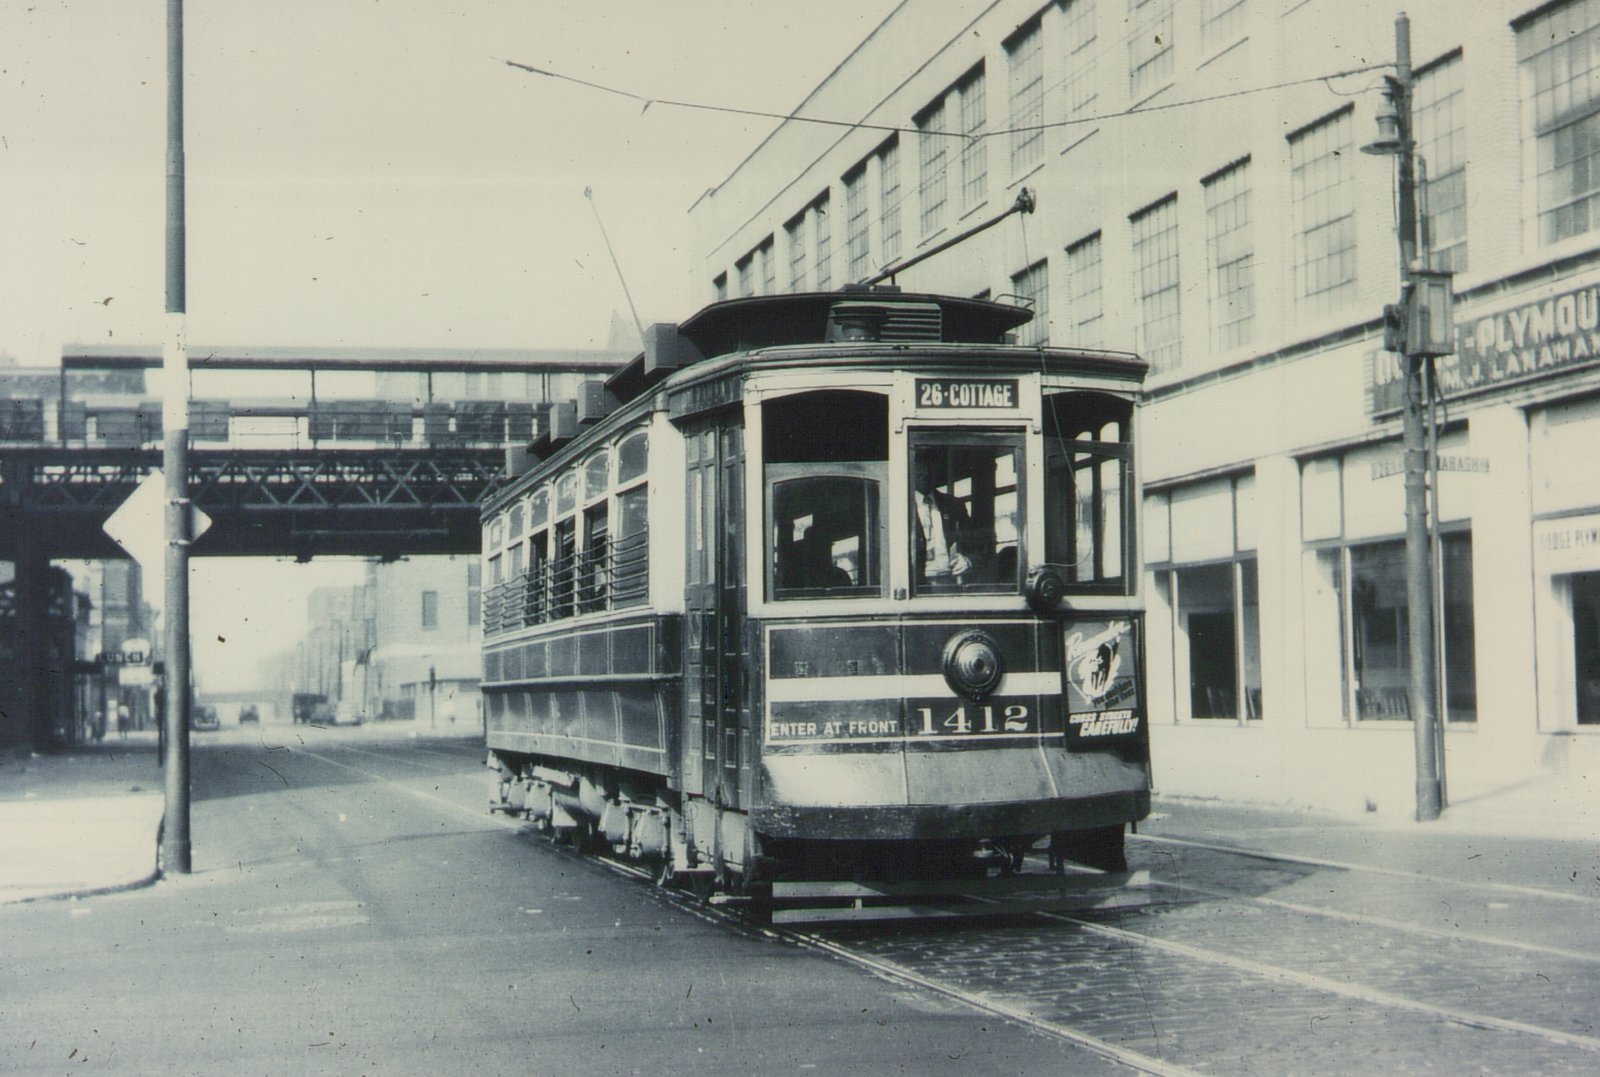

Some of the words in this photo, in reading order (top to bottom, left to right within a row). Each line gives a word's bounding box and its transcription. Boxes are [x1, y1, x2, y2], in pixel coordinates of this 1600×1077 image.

[1476, 286, 1600, 357] PLYMOU
[949, 383, 1013, 407] COTTAGE
[1574, 526, 1600, 548] PLYM
[770, 722, 817, 737] ENTER
[823, 721, 842, 735] AT
[849, 720, 897, 735] FRONT
[917, 705, 1029, 736] 1412
